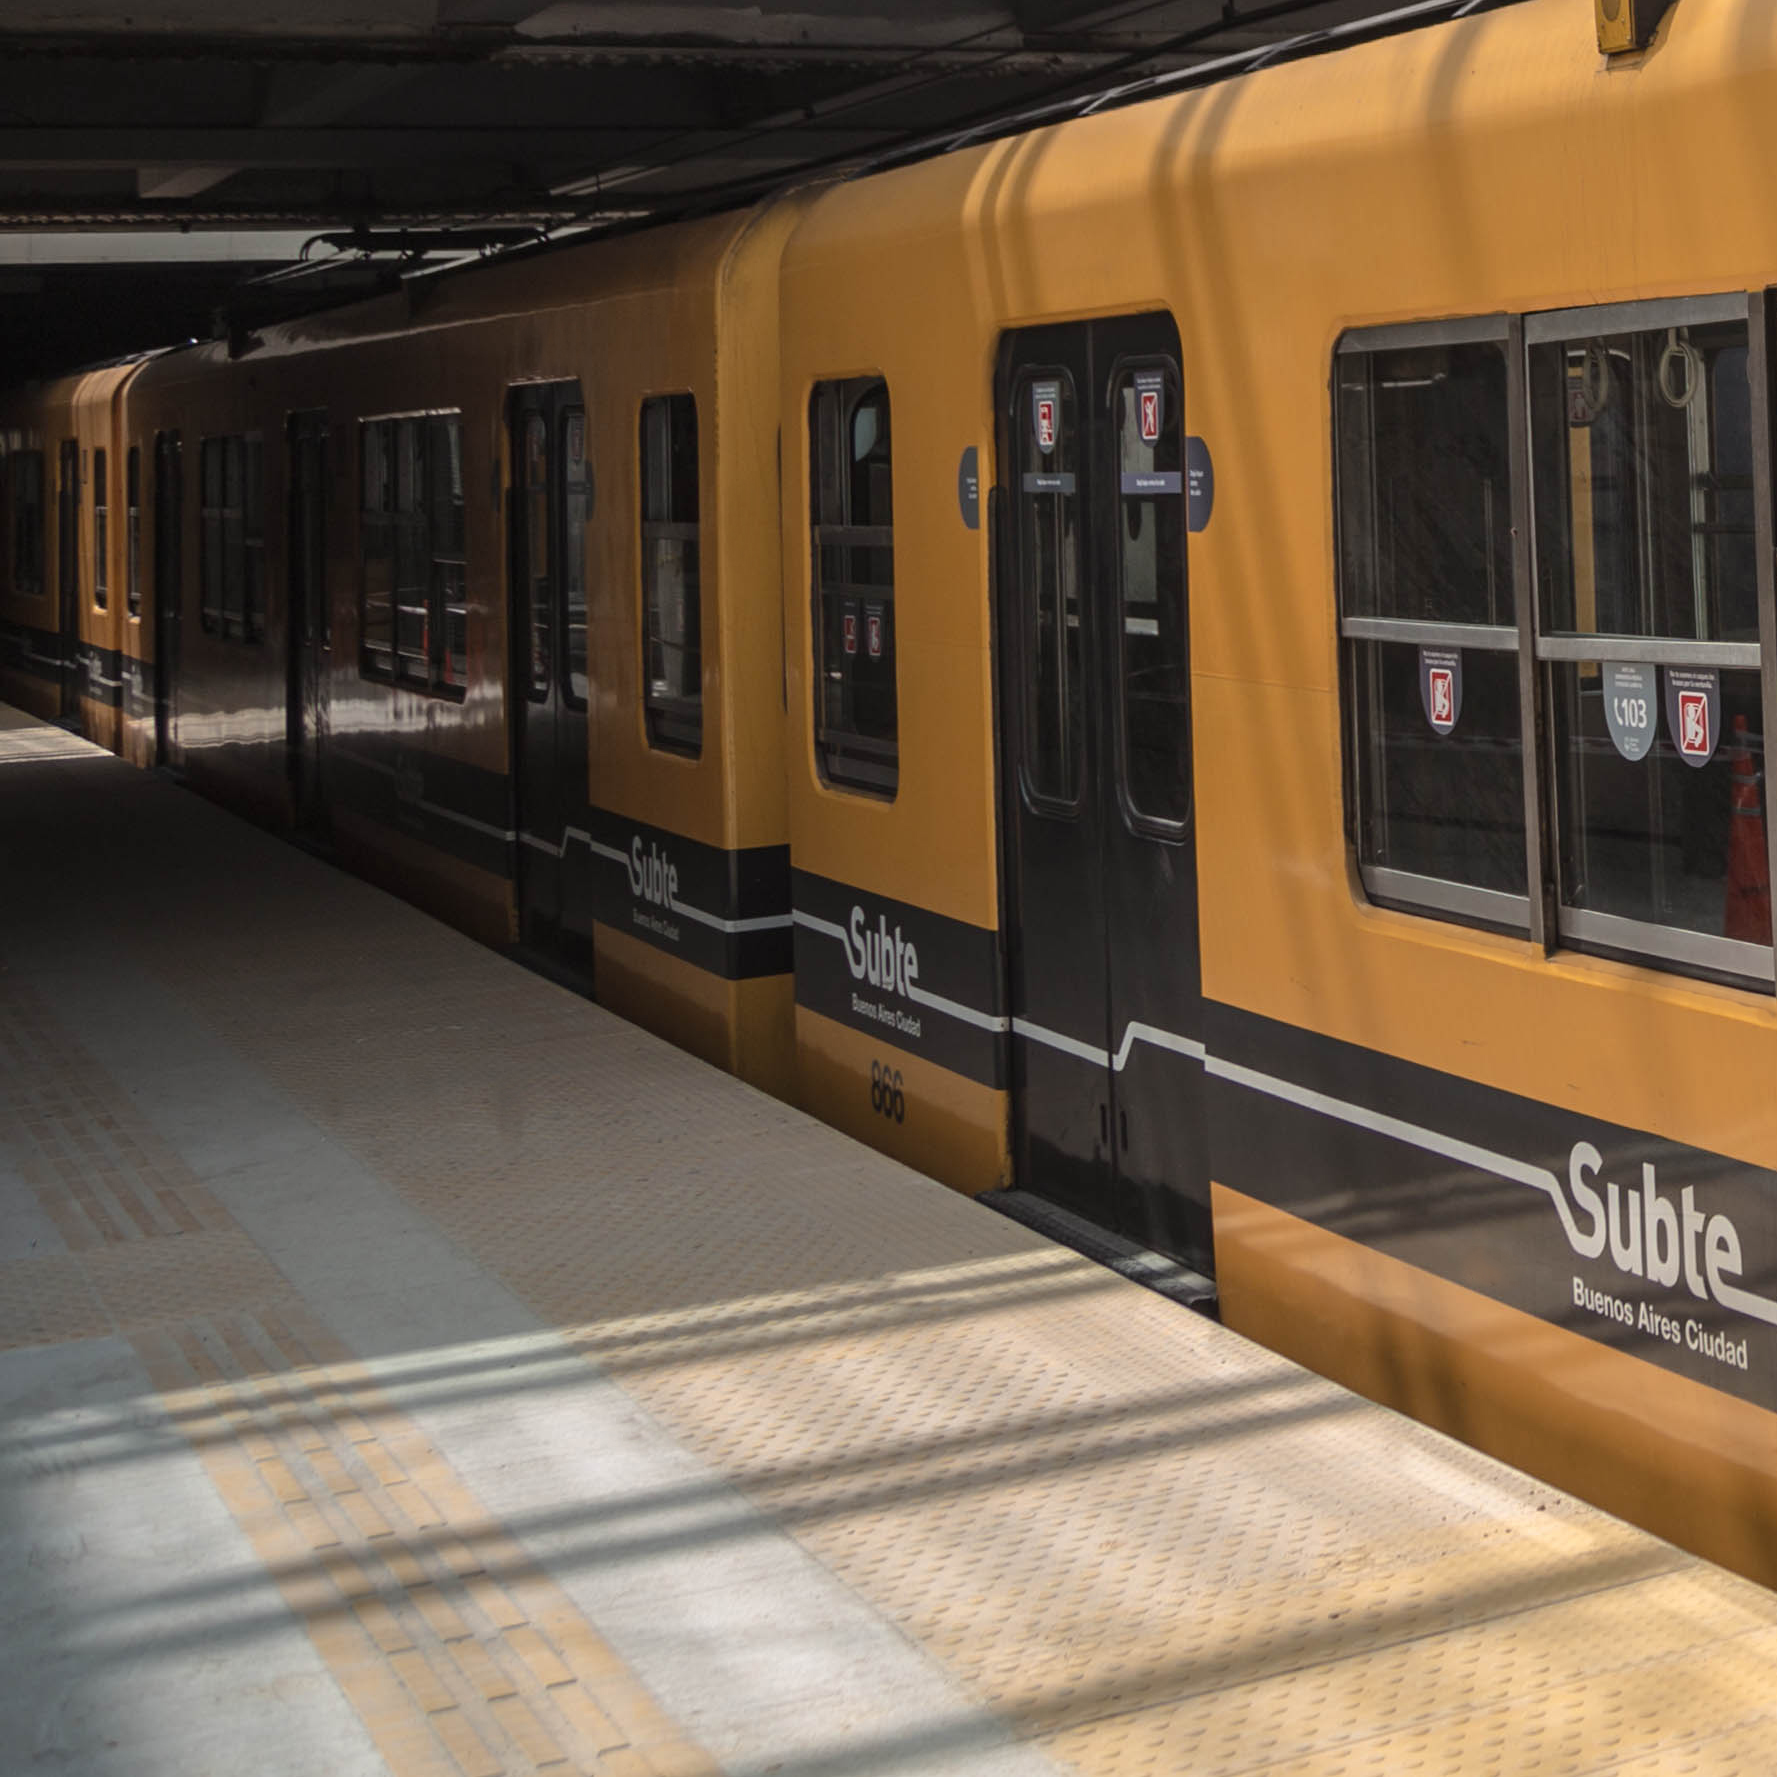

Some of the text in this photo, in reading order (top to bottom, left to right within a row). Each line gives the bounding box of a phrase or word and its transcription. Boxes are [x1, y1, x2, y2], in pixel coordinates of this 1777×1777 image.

[1622, 698, 1648, 728] 103
[632, 834, 678, 910] Subte
[850, 905, 919, 1000] Subte
[852, 992, 921, 1038] Buenos Aires Ciudad
[1565, 1141, 1743, 1307] Subte
[1573, 1276, 1748, 1370] Buenos Aires Ciudad
